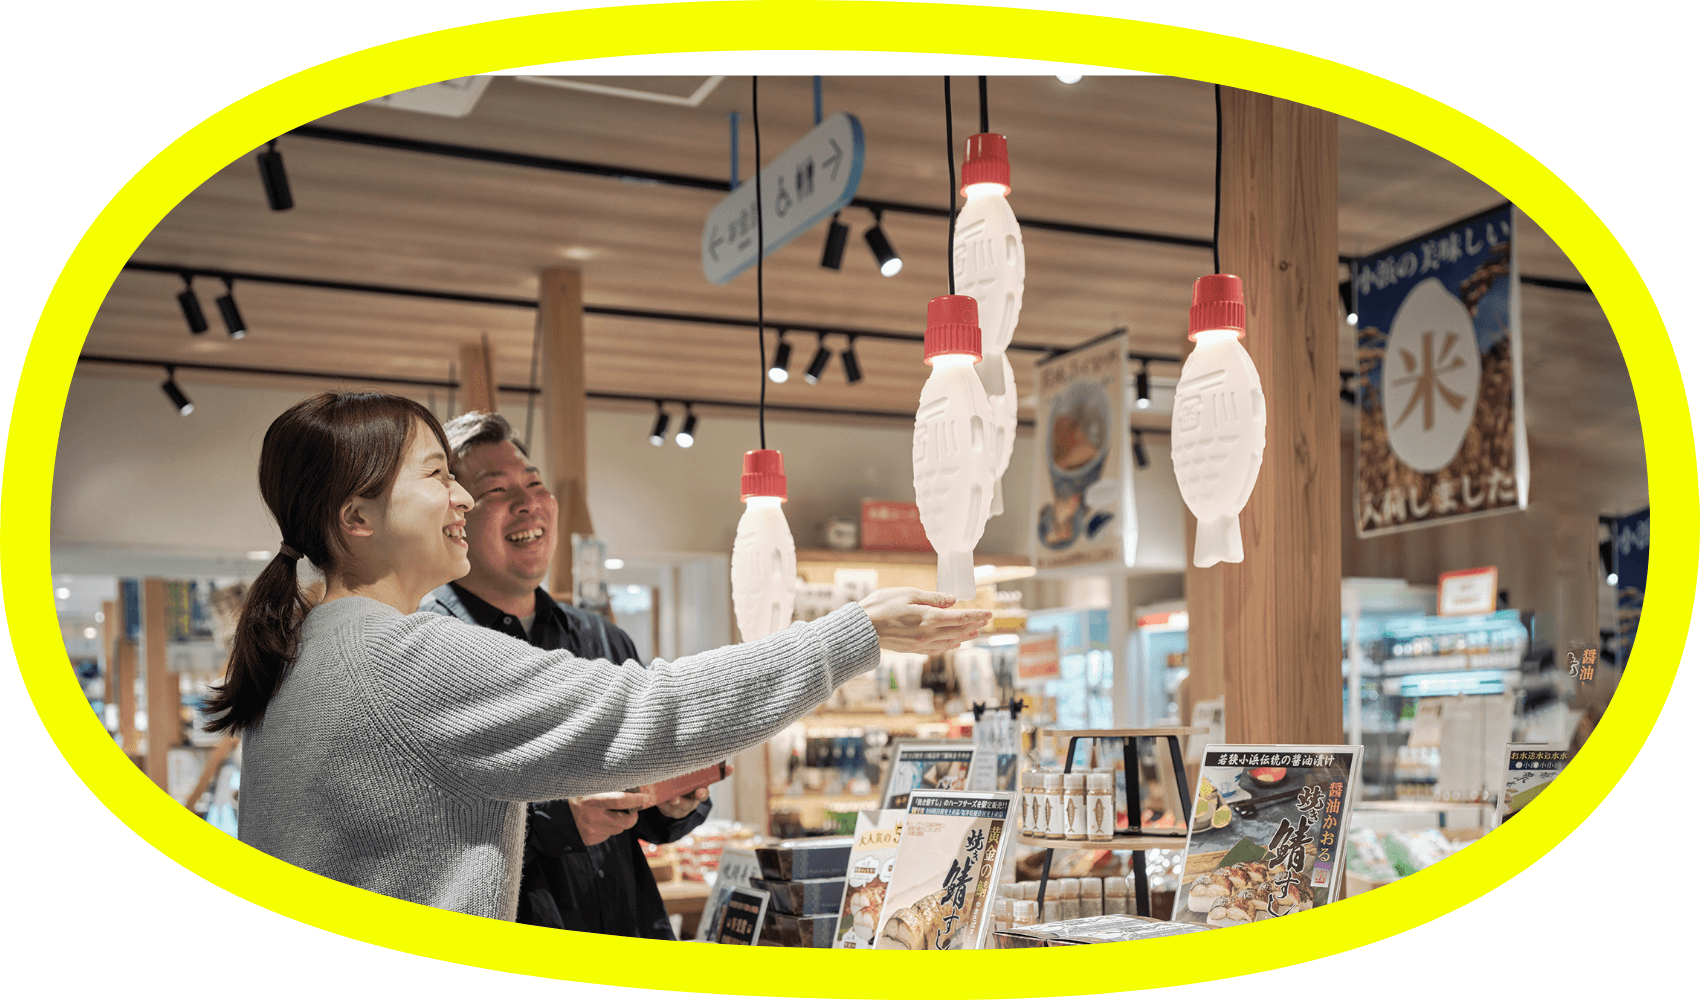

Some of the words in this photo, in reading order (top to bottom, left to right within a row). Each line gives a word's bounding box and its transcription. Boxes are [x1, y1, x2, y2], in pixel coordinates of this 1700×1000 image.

[1356, 220, 1509, 296] 小浜の美味しい
[1392, 330, 1468, 432] 米
[1360, 466, 1516, 529] 入荷しました
[1217, 753, 1335, 767] 若狭小浜伝統の醤油漬け
[1267, 785, 1326, 918] 焼き鯖すし
[1318, 781, 1344, 862] 醤油かおる
[935, 828, 985, 950] 焼き鯖すし
[975, 826, 1001, 898] 黄金の鯖
